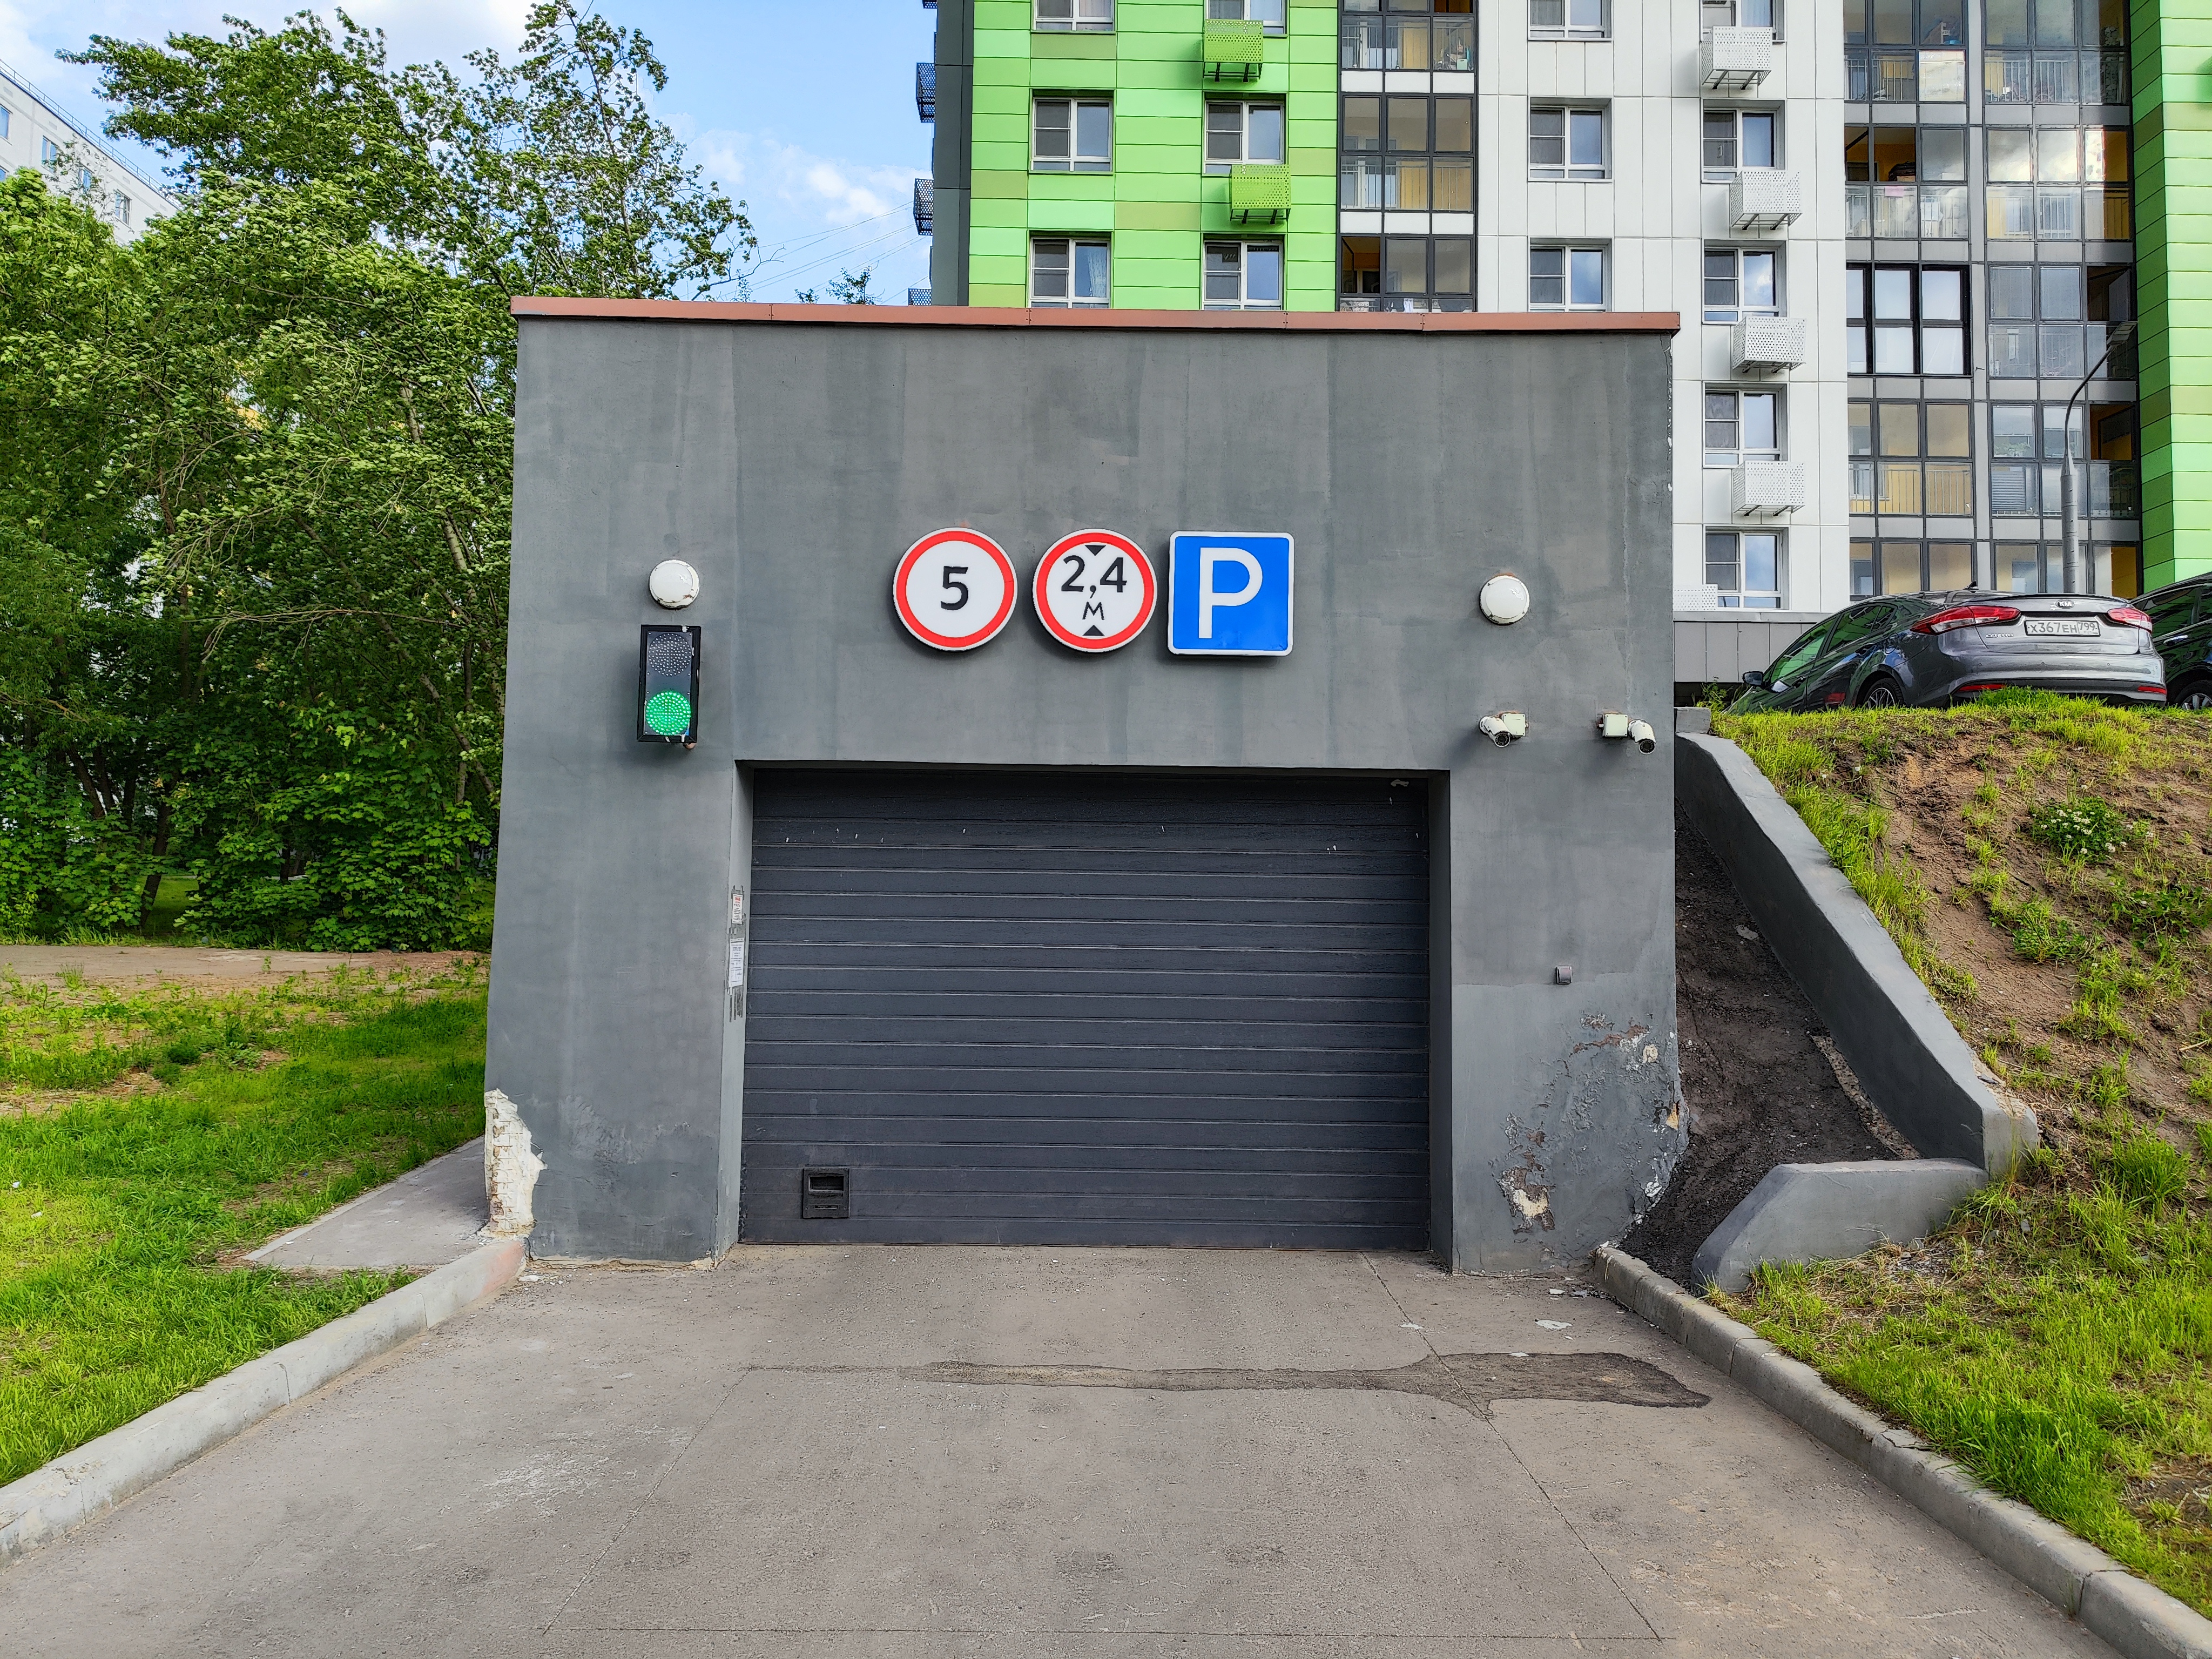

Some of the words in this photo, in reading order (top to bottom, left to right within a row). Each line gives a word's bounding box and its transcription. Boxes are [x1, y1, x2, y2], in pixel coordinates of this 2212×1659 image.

[940, 565, 969, 611] 5
[1061, 555, 1128, 598] 2,4
[1198, 547, 1263, 639] P
